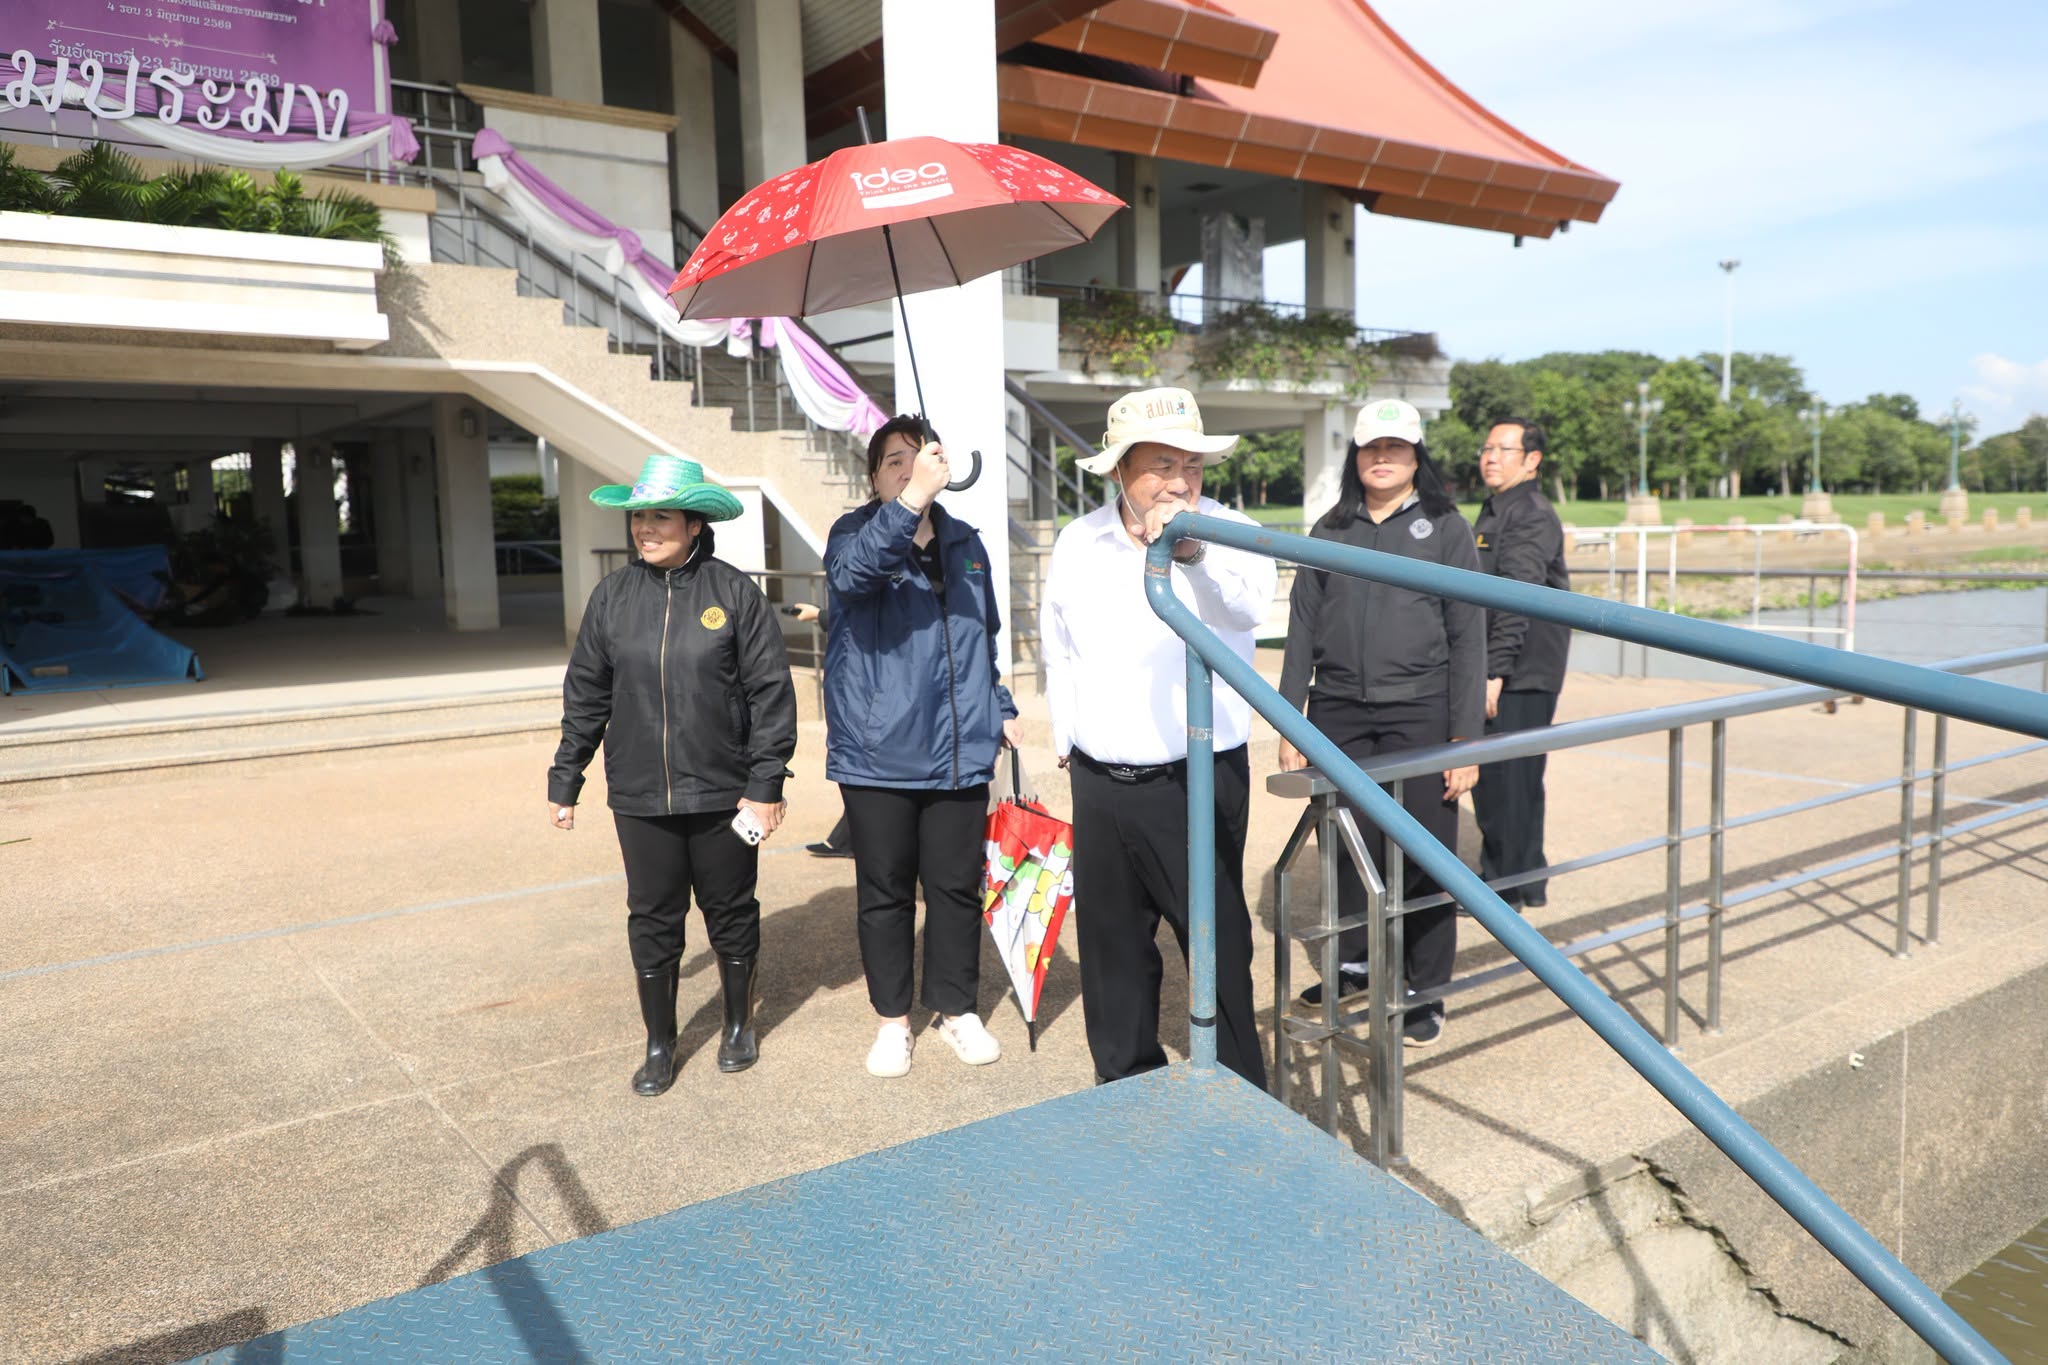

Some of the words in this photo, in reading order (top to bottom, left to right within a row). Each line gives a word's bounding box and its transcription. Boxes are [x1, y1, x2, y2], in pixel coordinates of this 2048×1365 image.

[107, 3, 115, 12] 4
[119, 5, 141, 16] รอบ
[145, 8, 153, 17] 3
[142, 56, 162, 69] 23
[850, 162, 947, 190] idea
